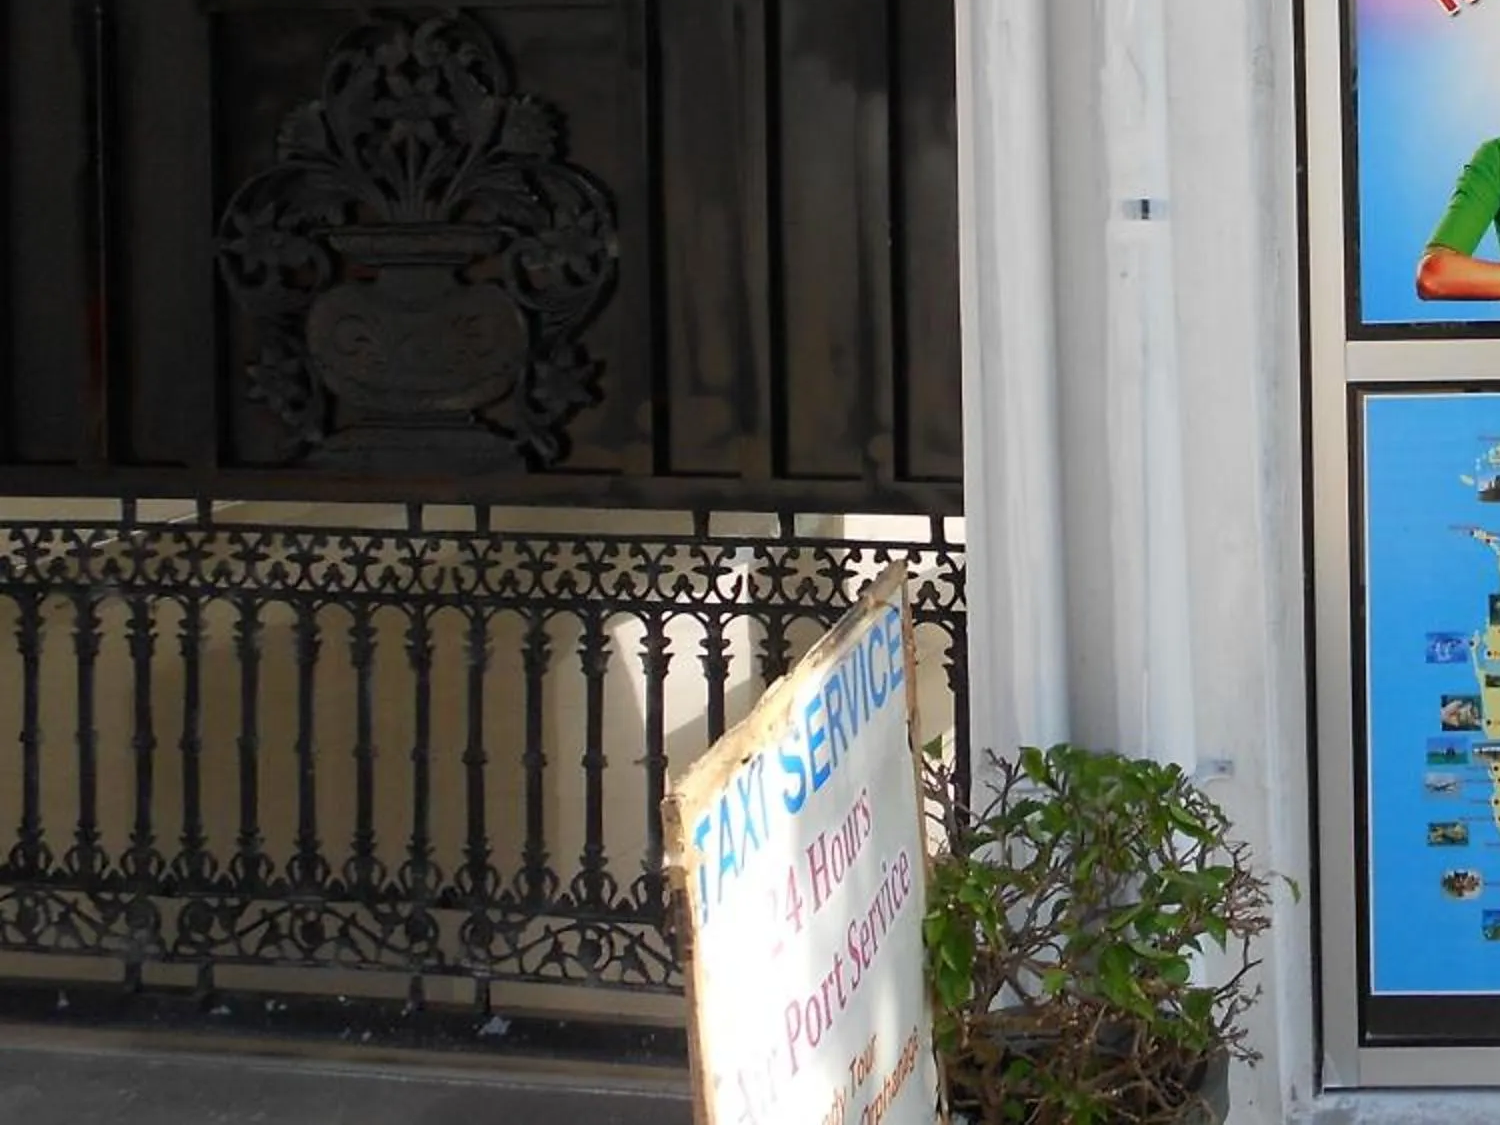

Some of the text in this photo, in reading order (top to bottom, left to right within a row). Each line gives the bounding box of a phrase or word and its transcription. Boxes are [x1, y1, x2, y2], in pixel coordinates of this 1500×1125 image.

[693, 607, 905, 929] TAXI SERVICE
[805, 785, 873, 915] Hours
[784, 951, 848, 1077] Port
[847, 847, 912, 992] Service
[849, 1033, 876, 1098] Tour
